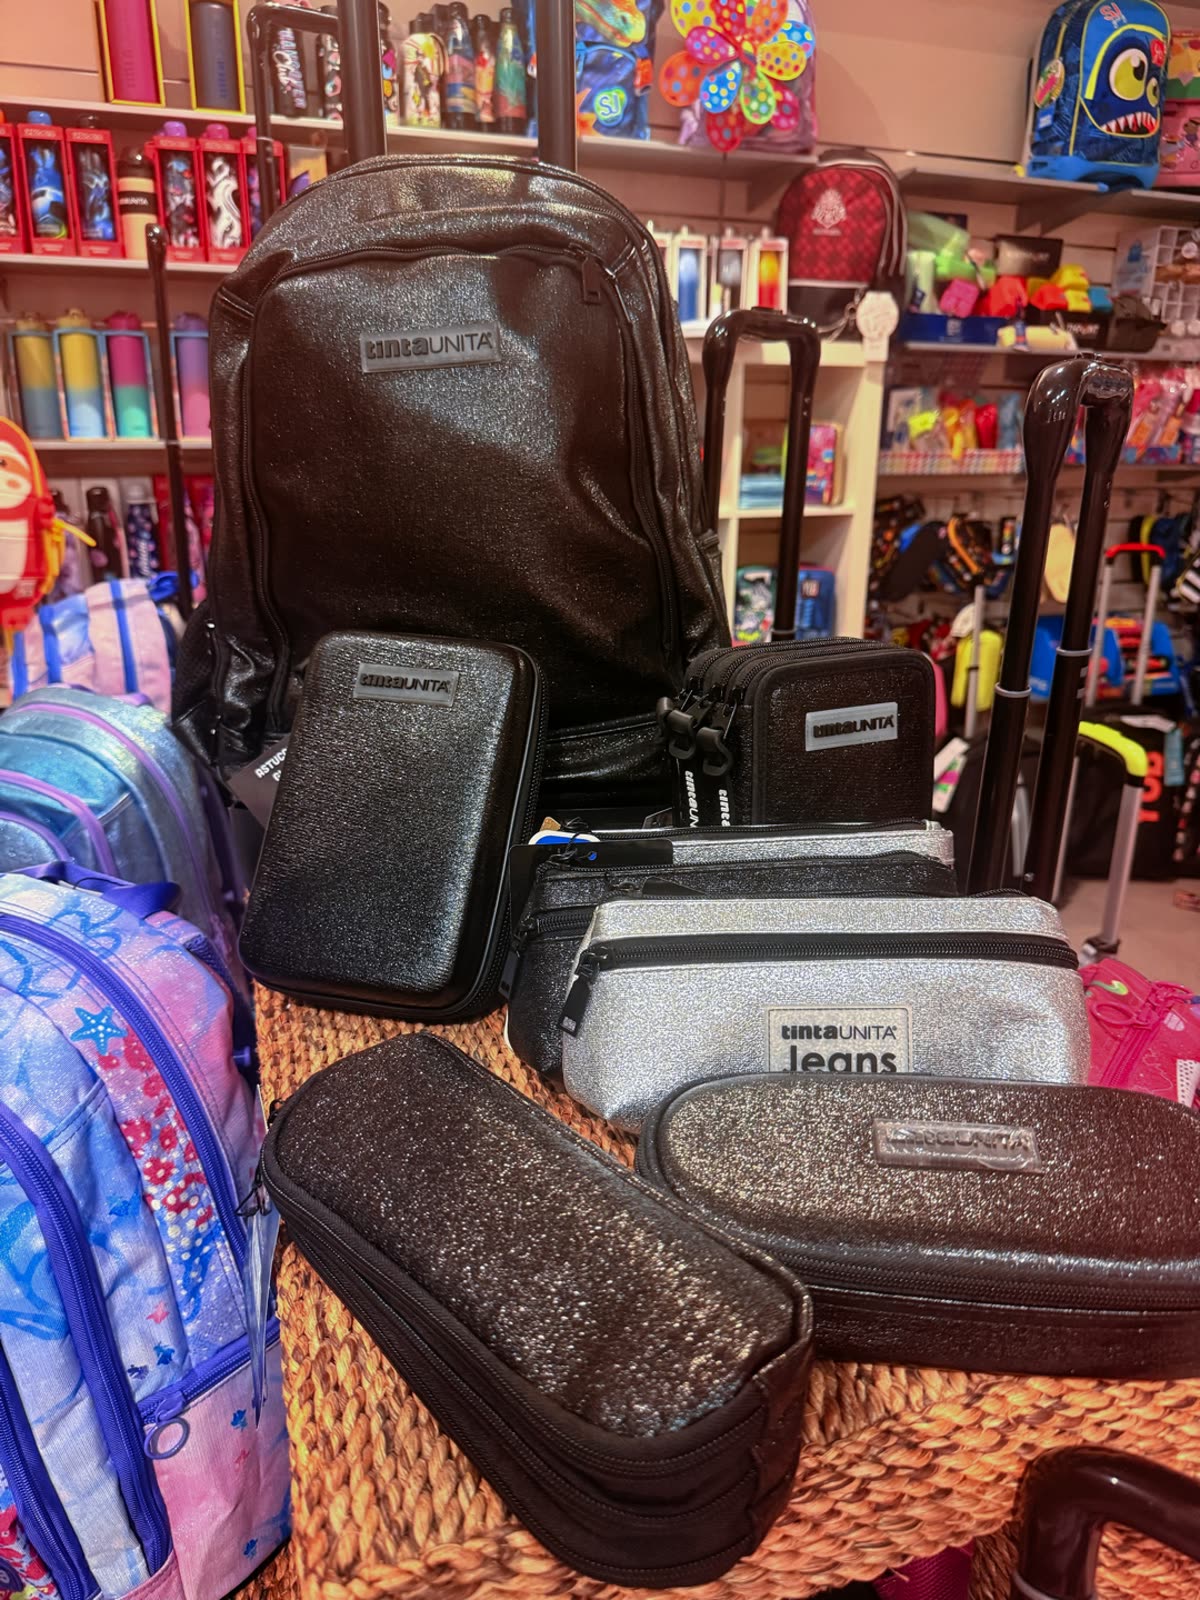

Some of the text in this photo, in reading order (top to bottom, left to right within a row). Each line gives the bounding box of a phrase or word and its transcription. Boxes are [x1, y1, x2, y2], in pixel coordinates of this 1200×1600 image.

[599, 94, 620, 117] SJ
[365, 331, 494, 360] tintaUNITA
[781, 1025, 897, 1040] tintaUNITA
